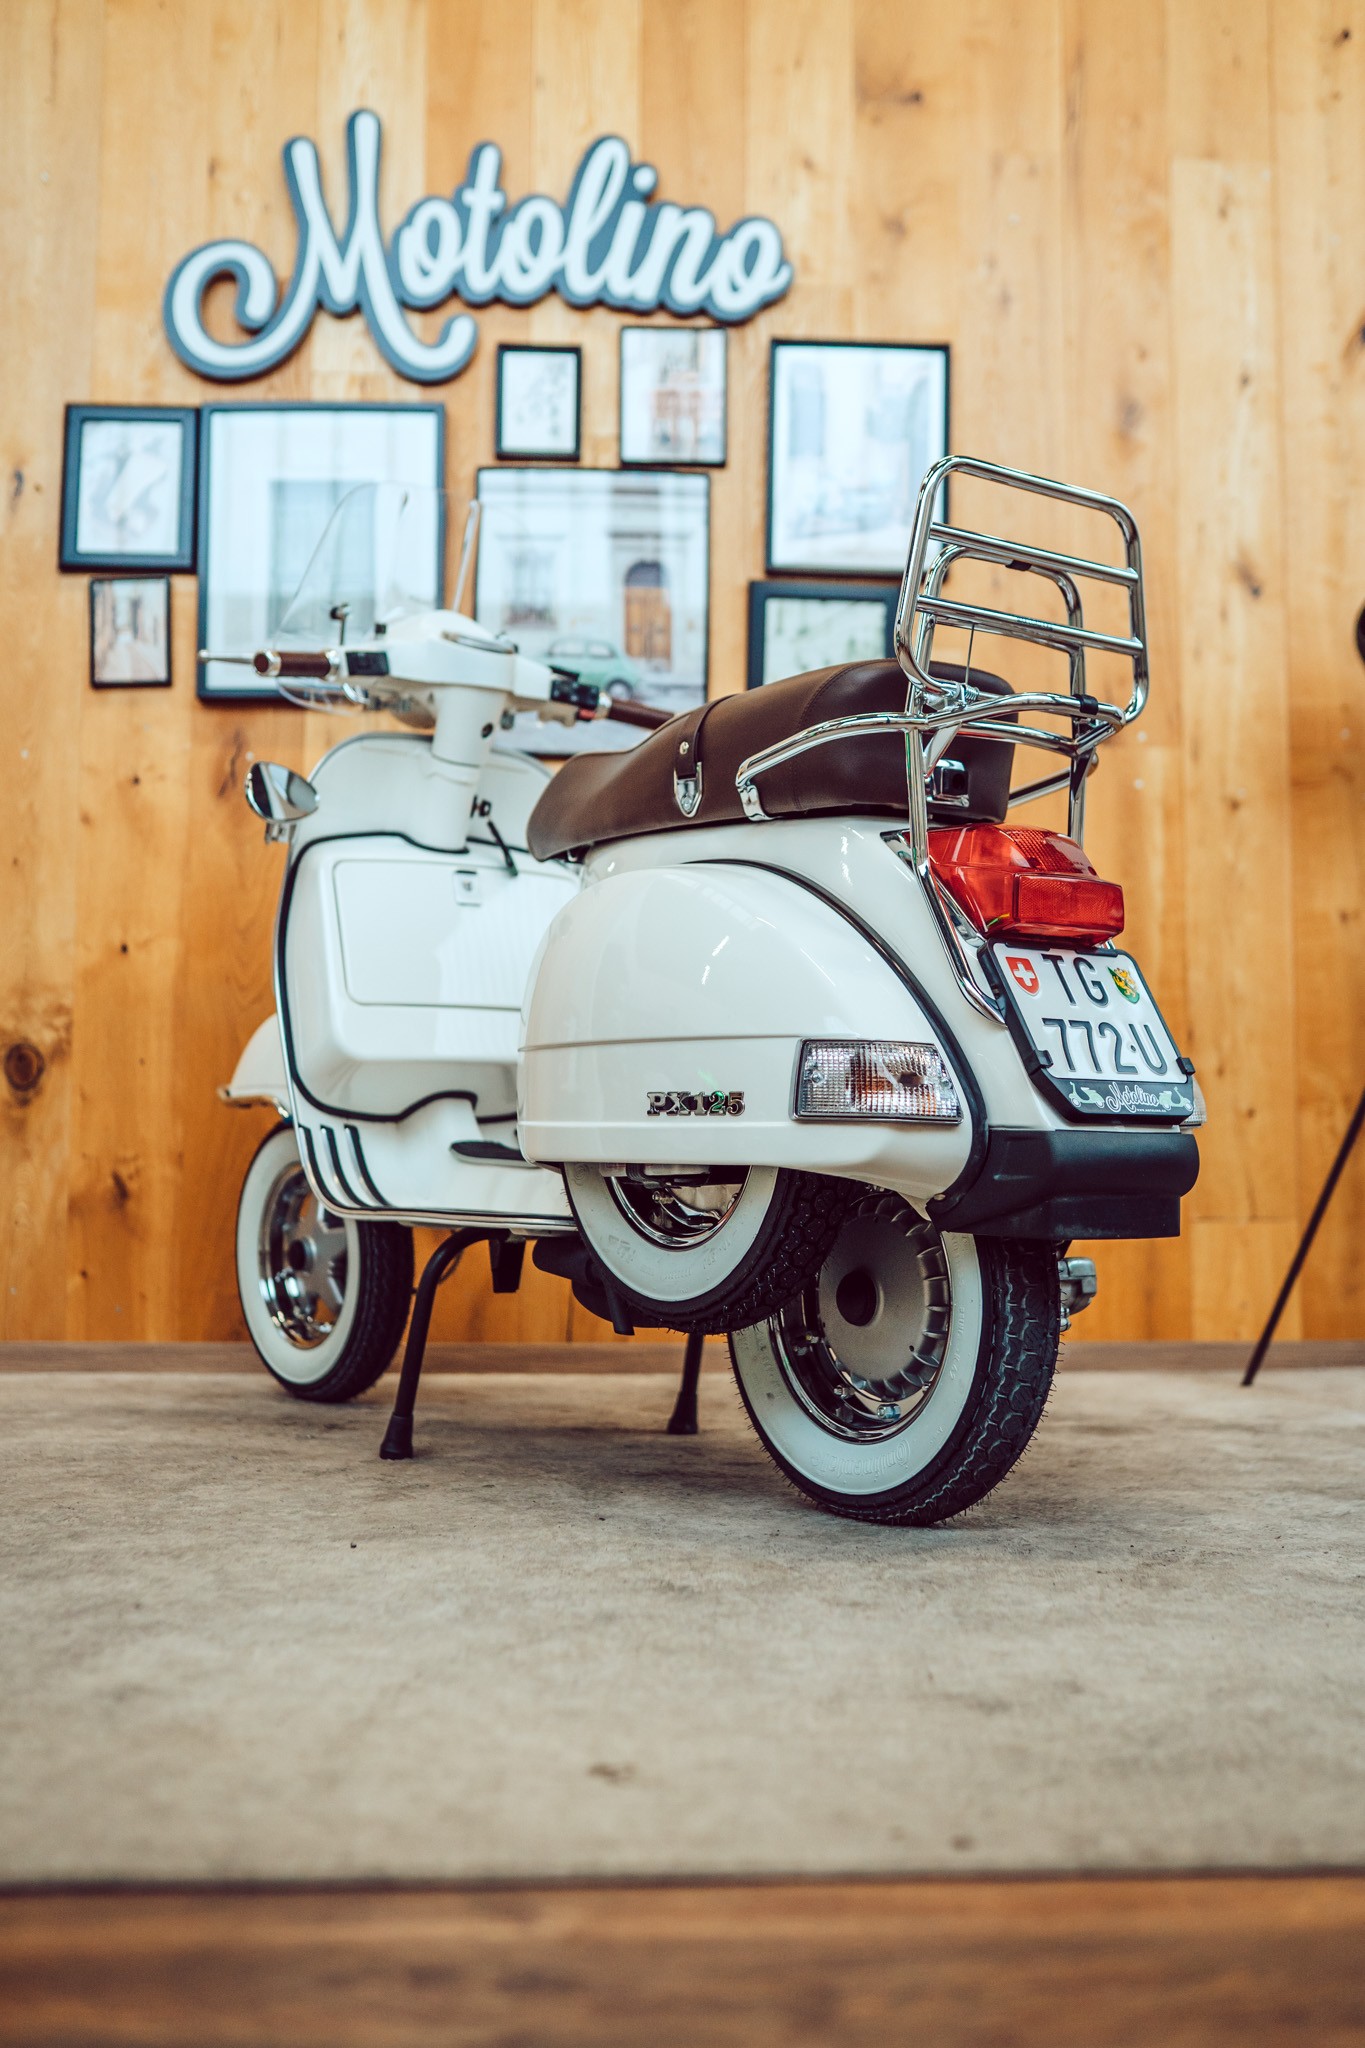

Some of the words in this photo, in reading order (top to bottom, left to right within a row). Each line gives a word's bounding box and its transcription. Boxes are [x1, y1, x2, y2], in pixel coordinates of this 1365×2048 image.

[164, 110, 793, 383] Motolino
[1041, 953, 1109, 1008] TG
[1106, 1081, 1160, 1113] Motolino
